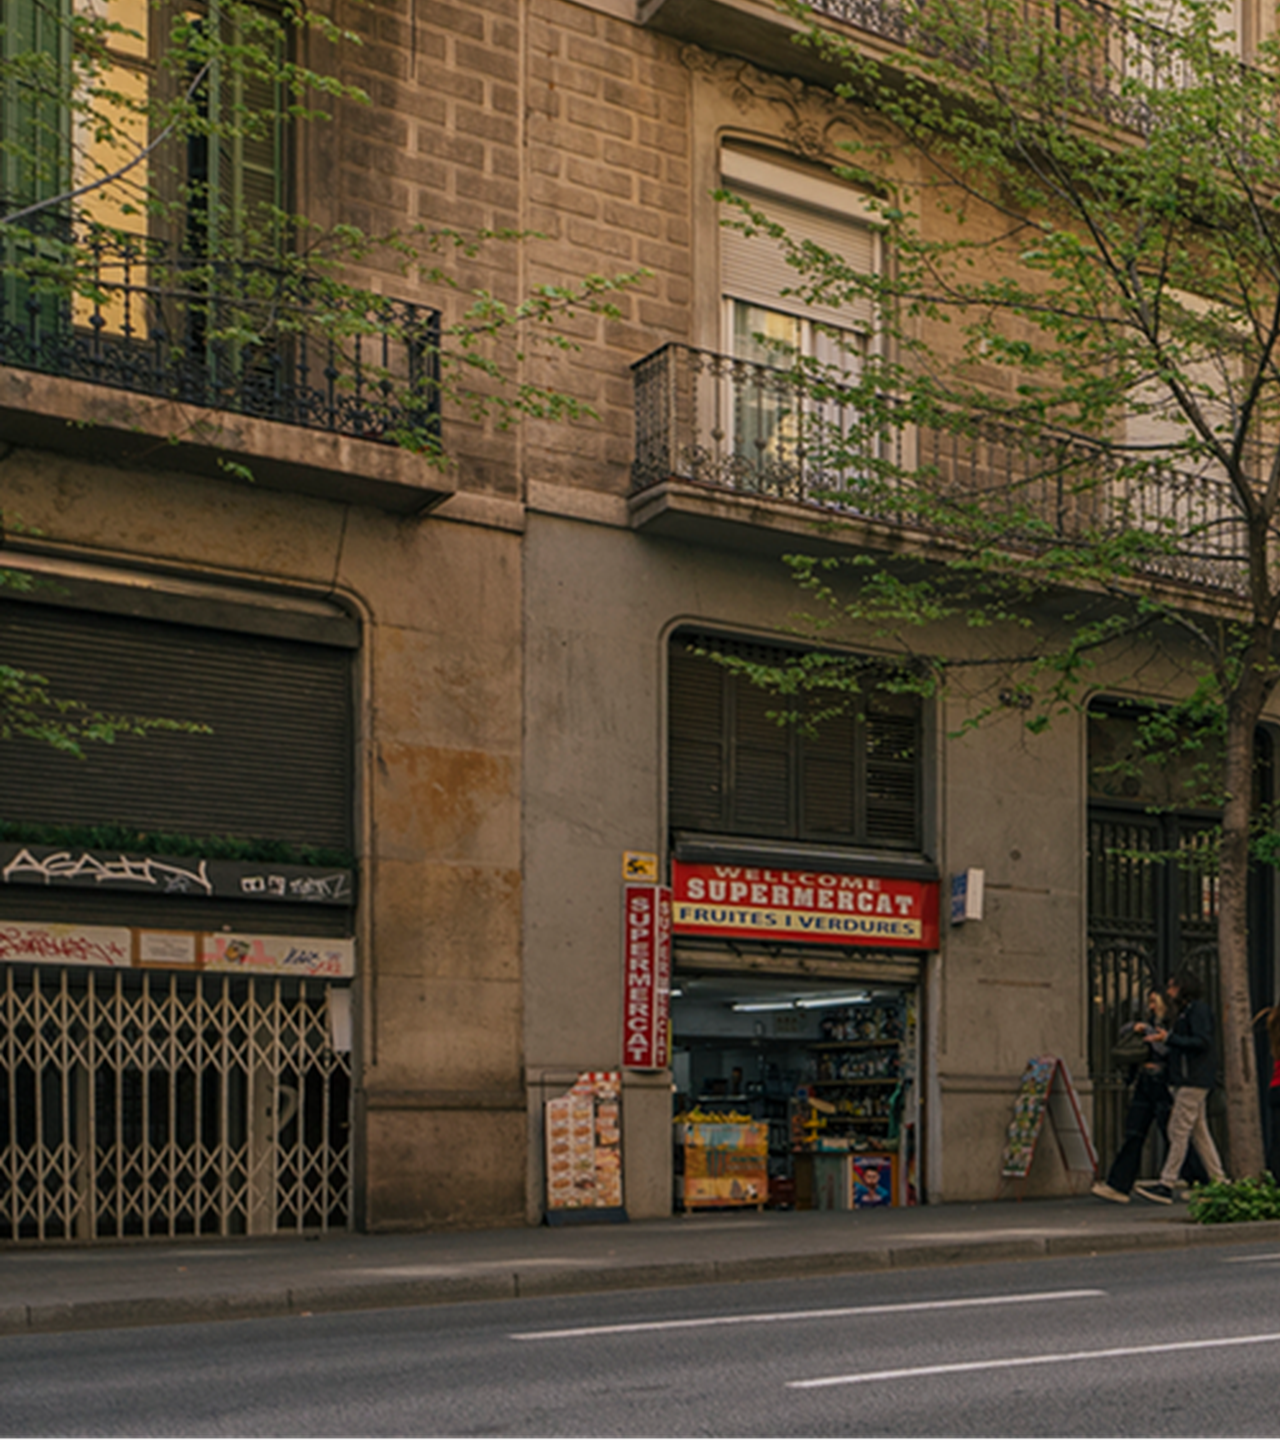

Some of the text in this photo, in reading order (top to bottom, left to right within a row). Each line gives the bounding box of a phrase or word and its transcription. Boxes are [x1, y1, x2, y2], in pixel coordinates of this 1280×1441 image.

[714, 866, 881, 891] WELLCOME
[686, 877, 914, 916] SUPERMERCAT
[680, 907, 915, 936] FRUITES I VERDURES
[628, 895, 651, 1062] SUPERMERCAT
